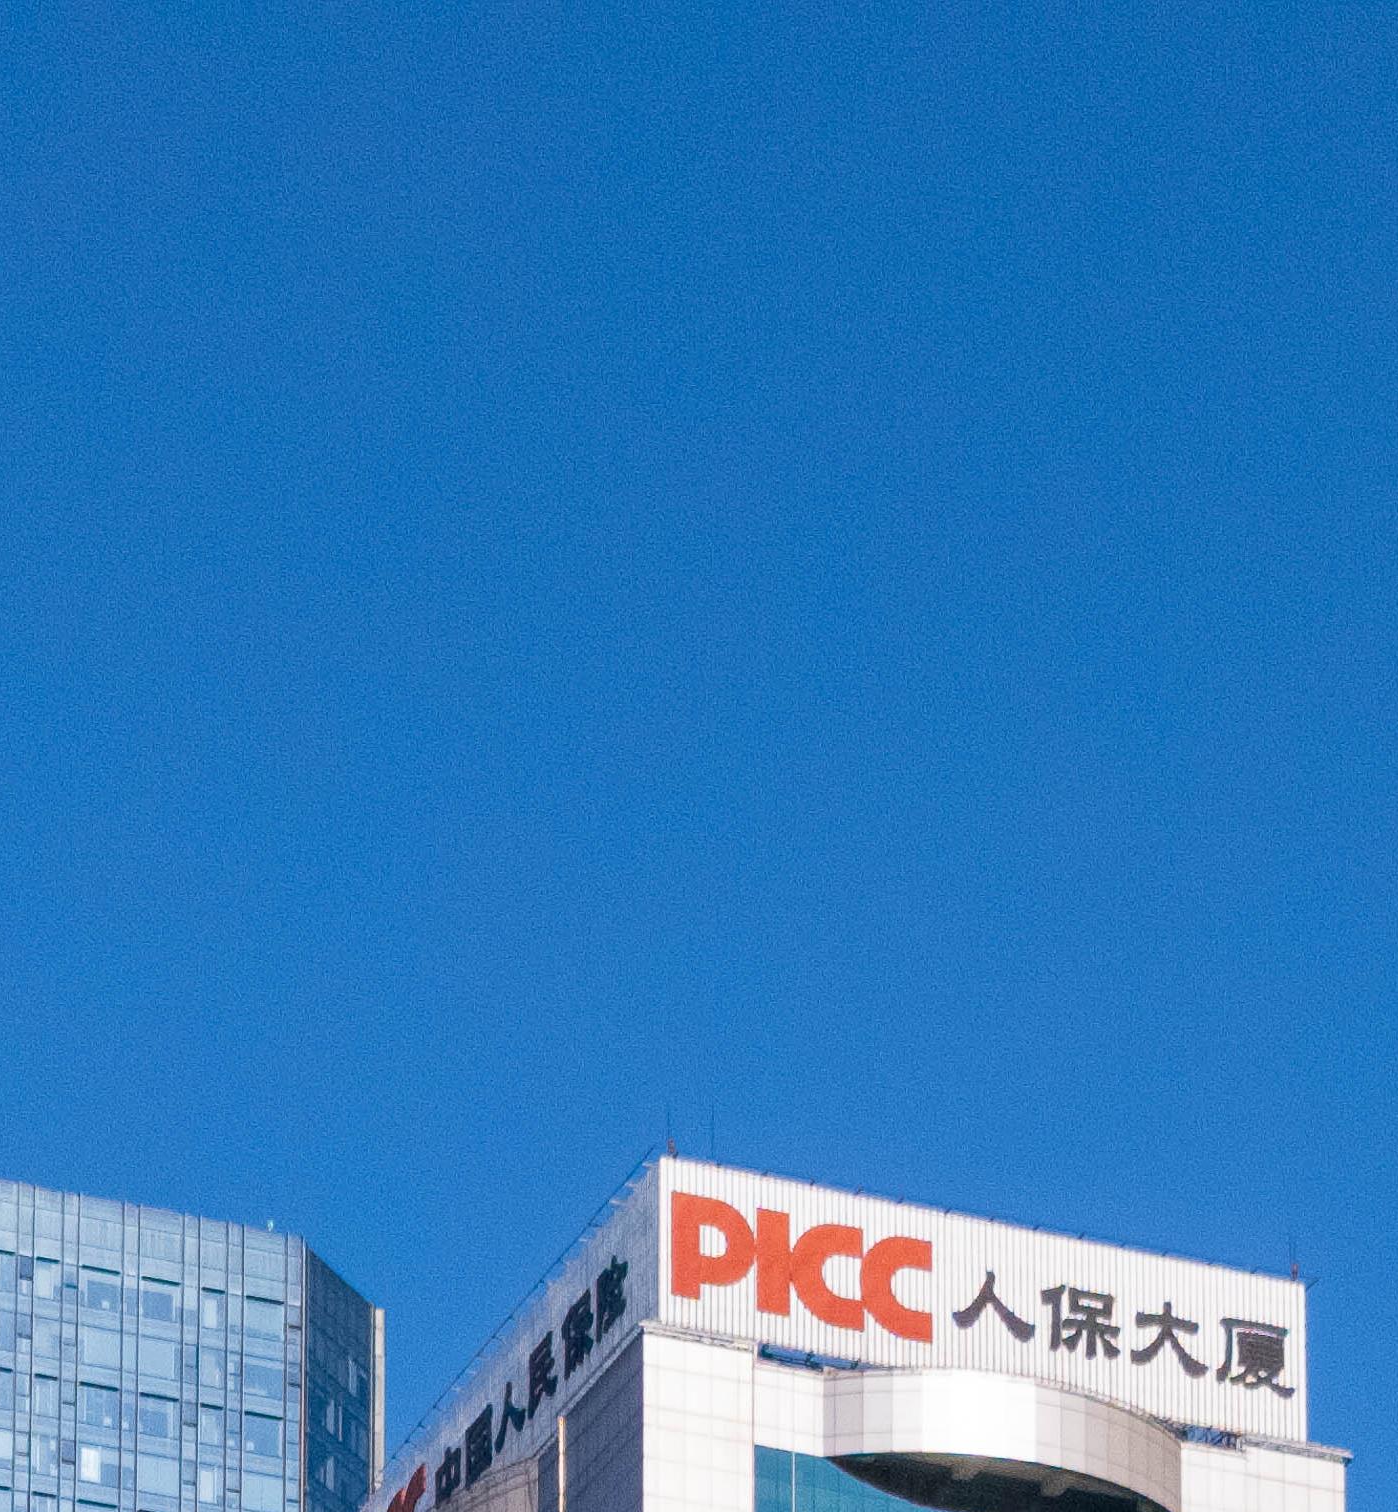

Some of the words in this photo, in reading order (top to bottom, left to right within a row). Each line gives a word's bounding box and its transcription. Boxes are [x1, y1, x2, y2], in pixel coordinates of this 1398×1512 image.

[670, 1190, 933, 1344] PICC
[952, 1271, 1296, 1398] 人保大厦
[434, 1255, 629, 1508] 中国人民保险
